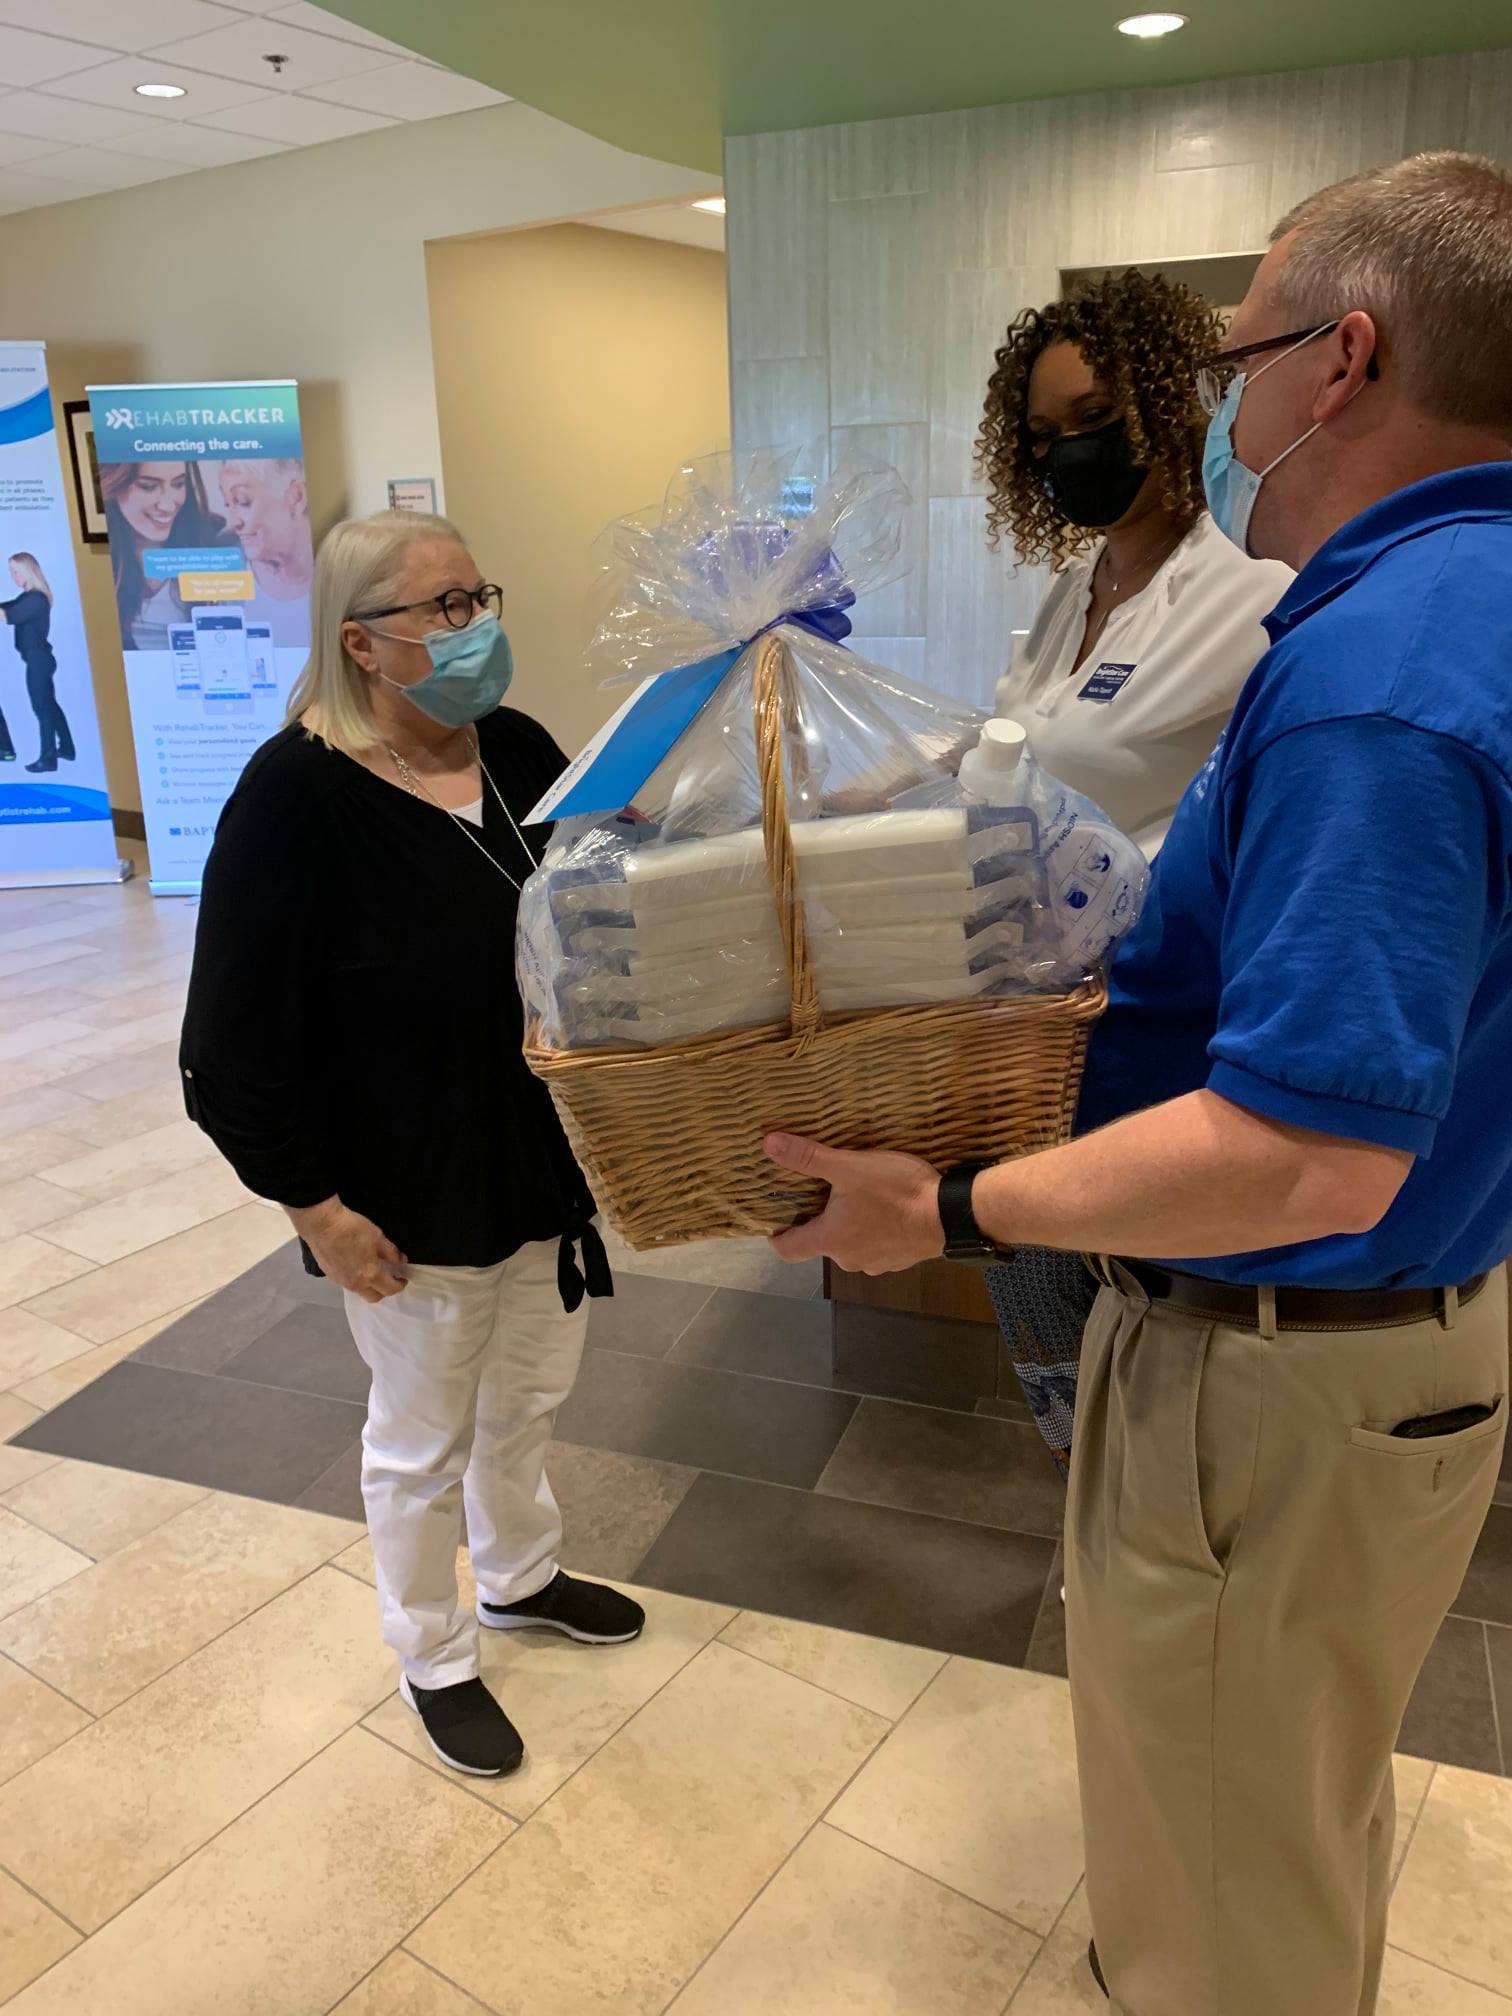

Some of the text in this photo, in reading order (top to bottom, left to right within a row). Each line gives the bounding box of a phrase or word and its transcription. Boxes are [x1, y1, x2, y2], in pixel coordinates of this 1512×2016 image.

[134, 438, 263, 453] Connecting the care.
